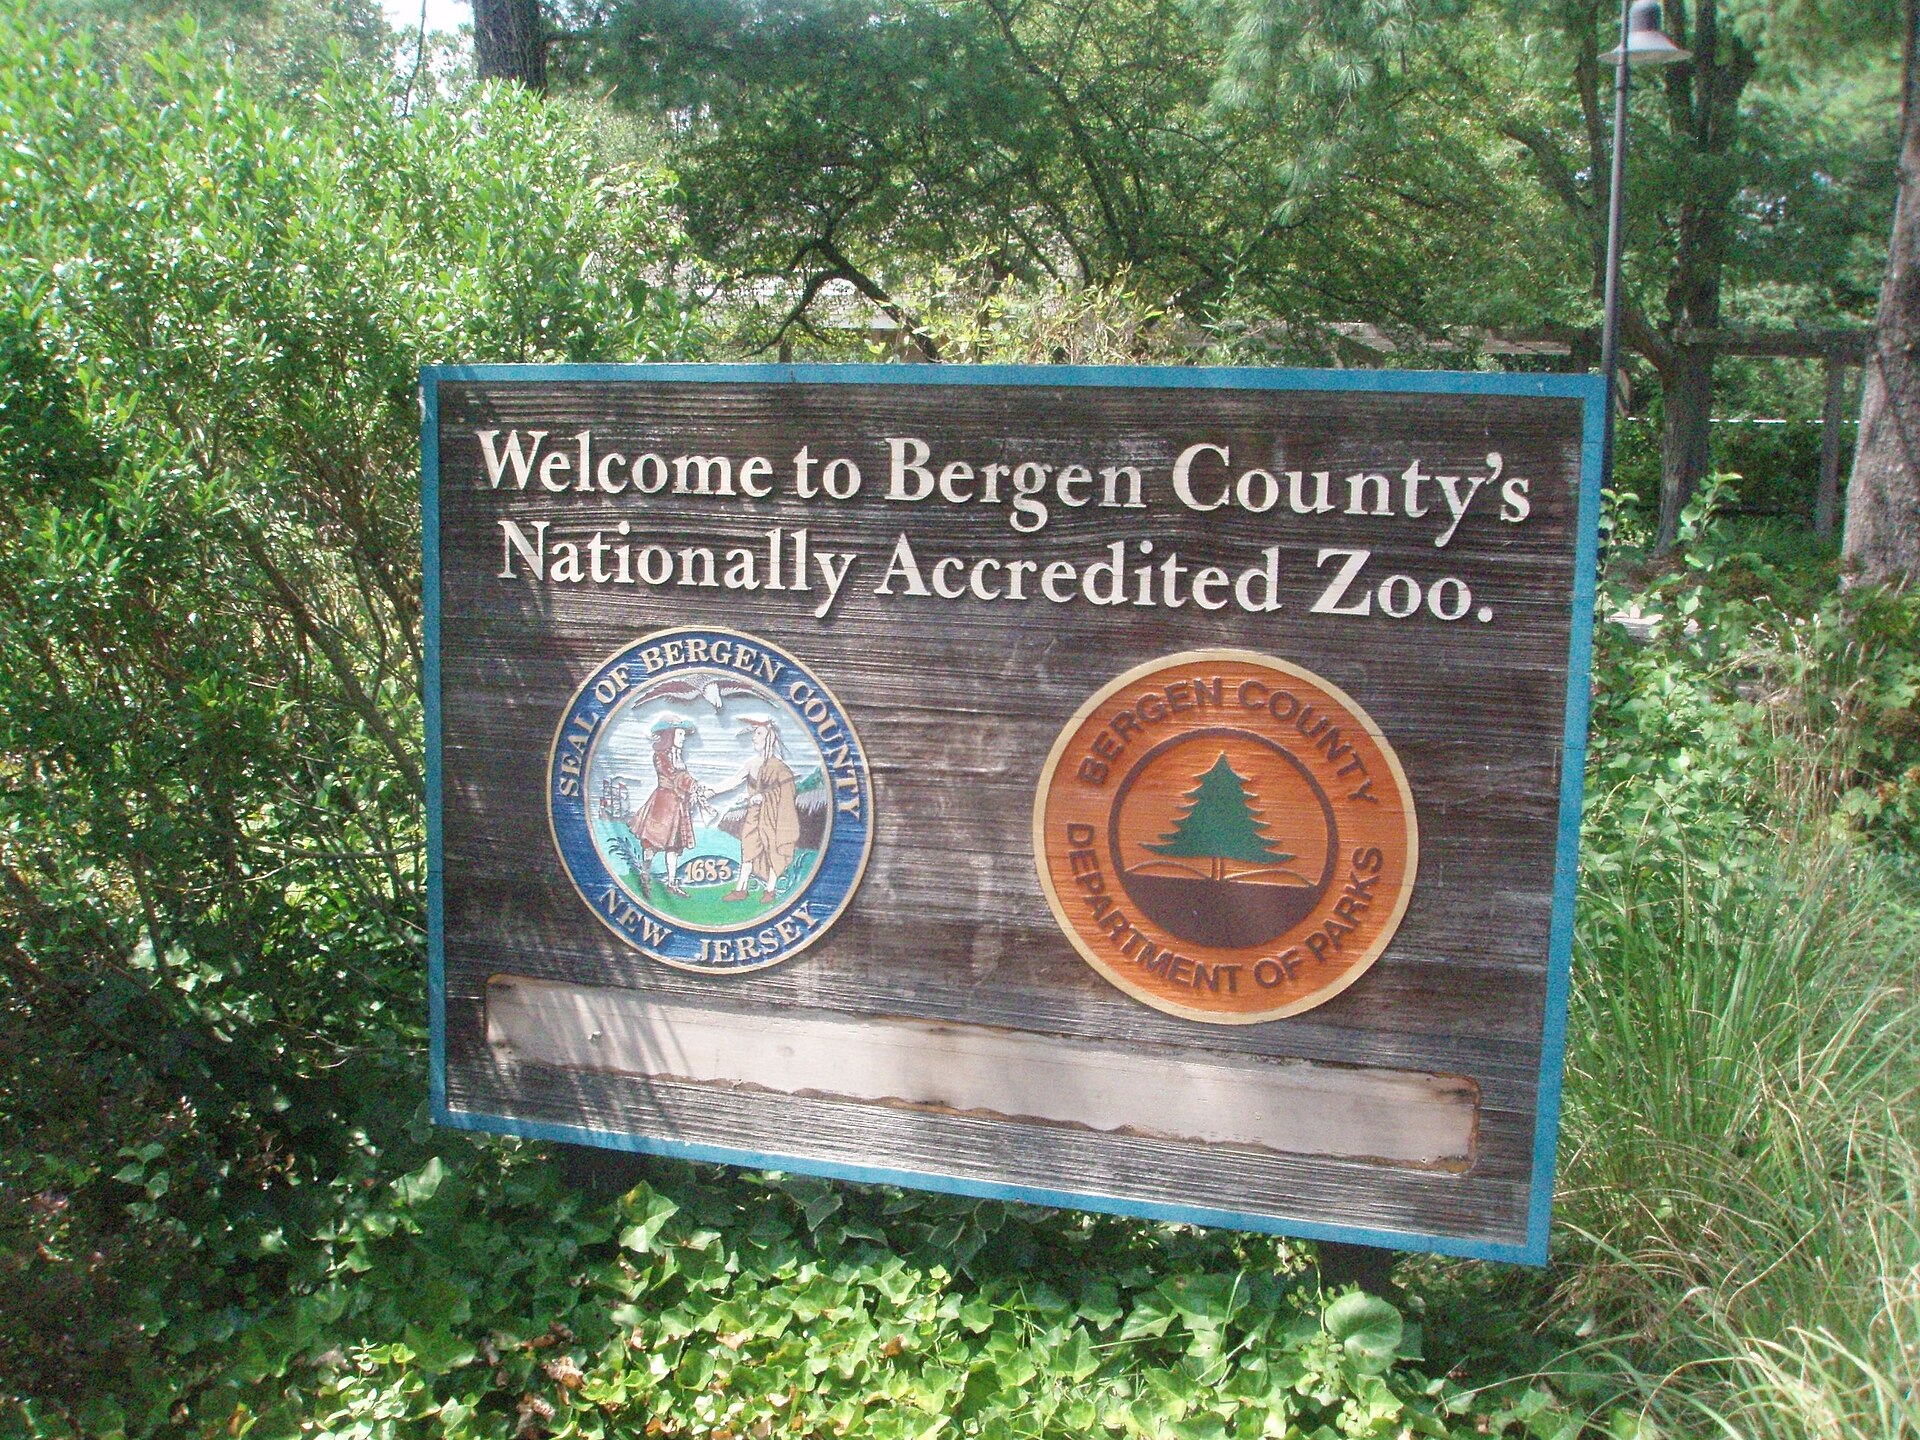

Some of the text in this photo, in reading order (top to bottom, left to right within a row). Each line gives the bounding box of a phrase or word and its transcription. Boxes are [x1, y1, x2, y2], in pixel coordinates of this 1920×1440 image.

[476, 430, 1531, 547] Welcome to Bergen County's
[497, 520, 1494, 623] Nationally Accredited Zoo.
[560, 638, 860, 822] SEAL OF BERGEN COUNTY
[1078, 676, 1378, 804] BERGEN COUNTY
[598, 887, 821, 964] NEW JERSEY
[684, 860, 733, 884] 1683
[1066, 822, 1384, 994] DEPARTMENT OF PARKS
